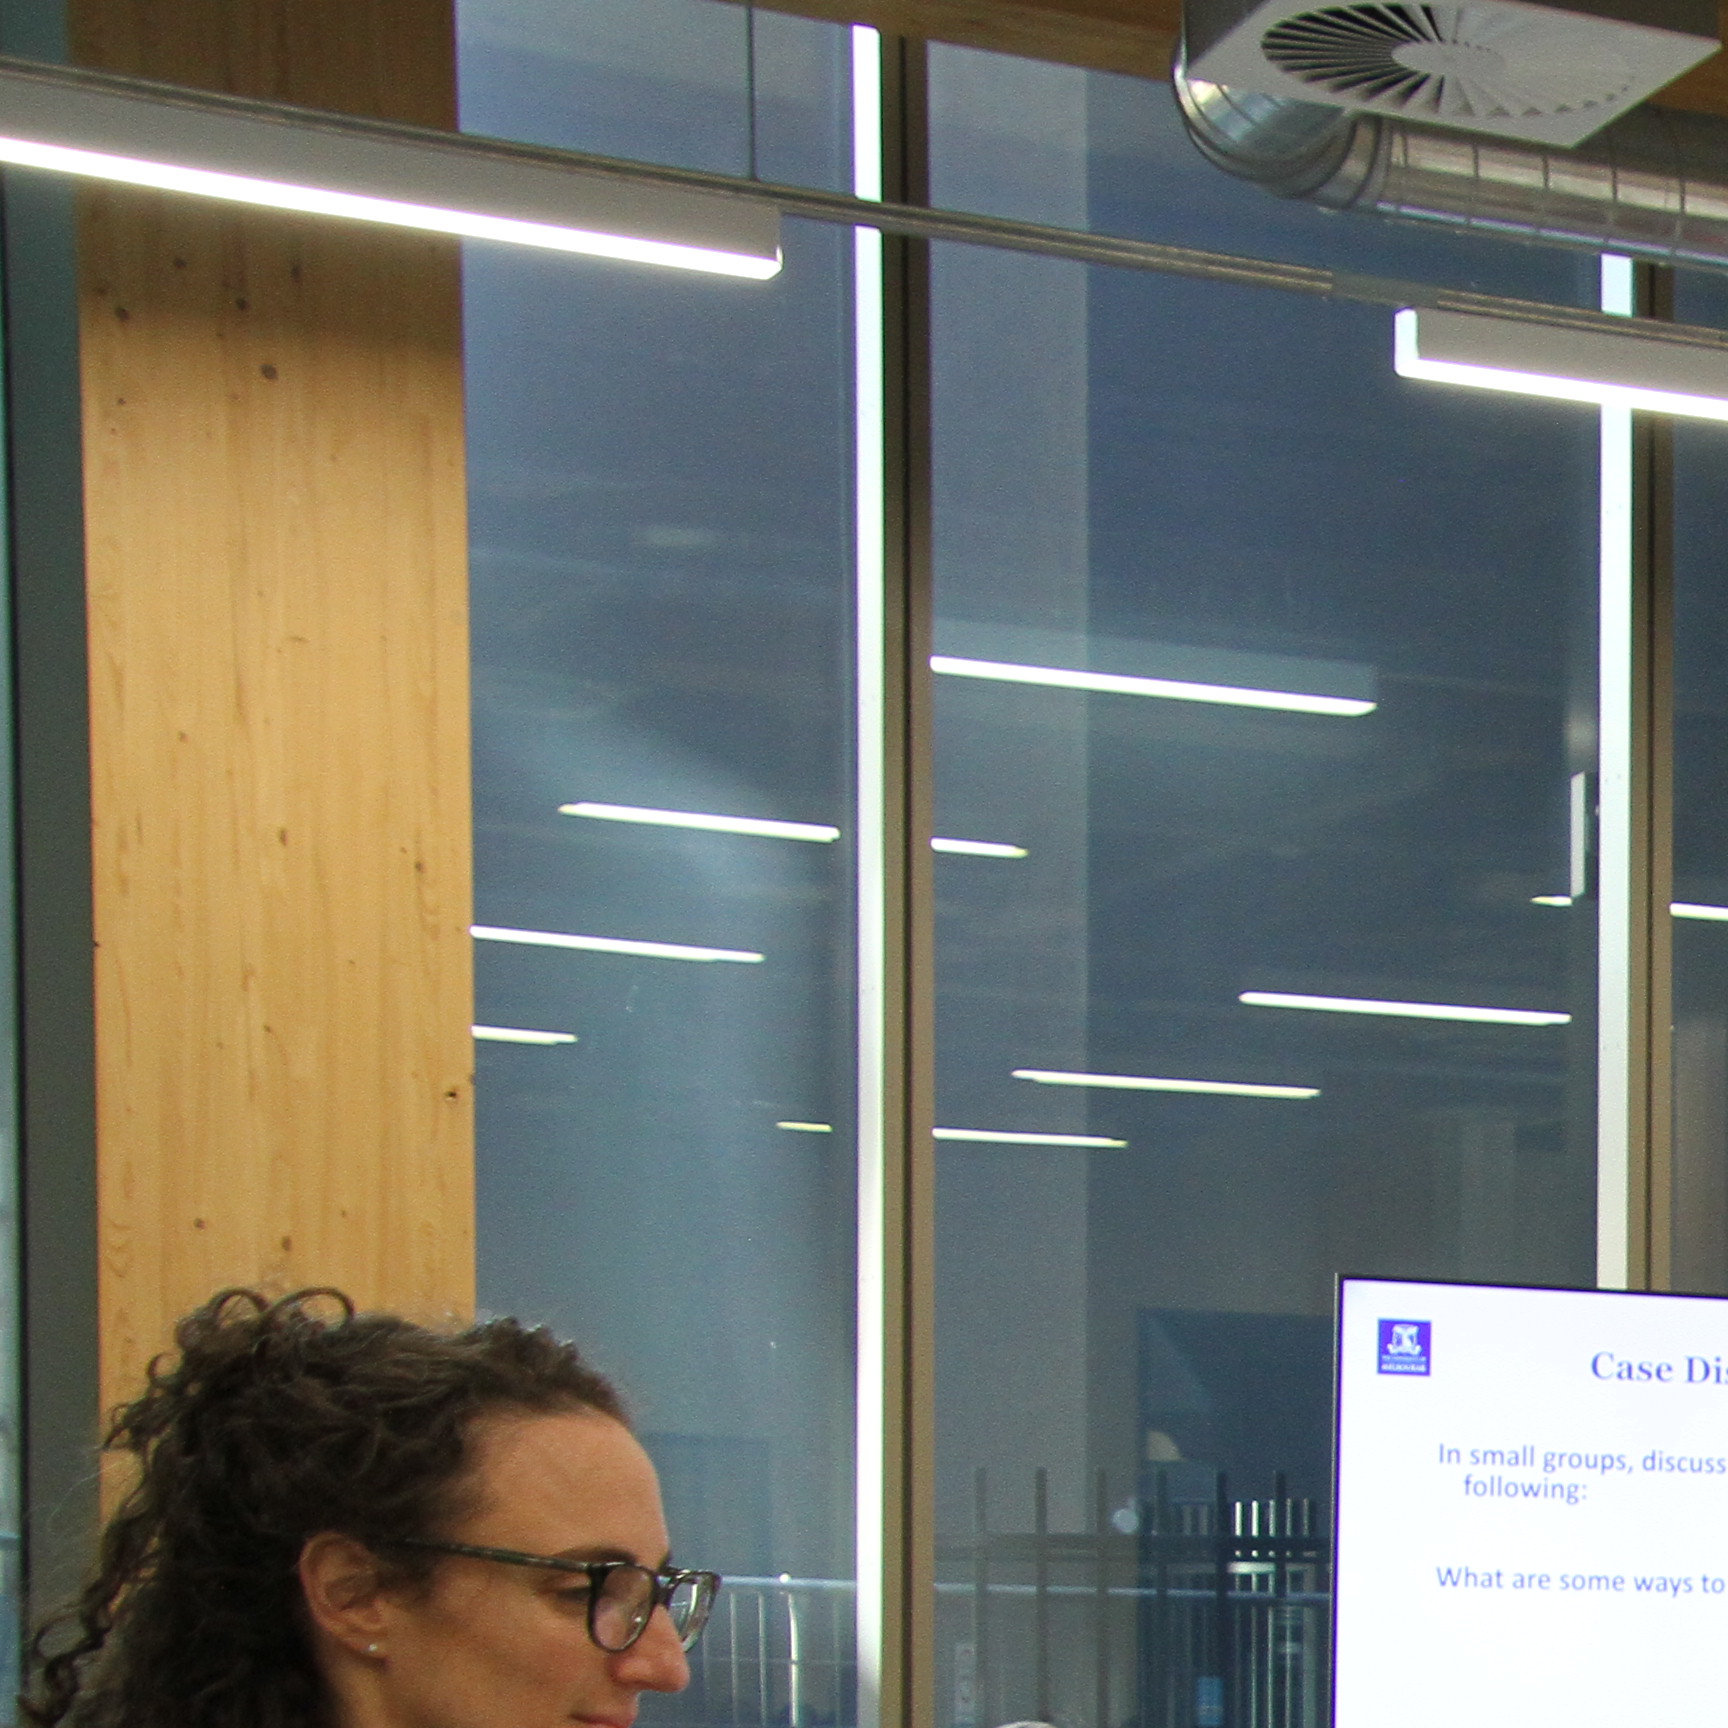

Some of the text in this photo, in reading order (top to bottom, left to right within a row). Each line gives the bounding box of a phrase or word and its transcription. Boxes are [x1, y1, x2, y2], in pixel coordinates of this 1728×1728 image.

[1589, 1351, 1674, 1383] Case
[1438, 1442, 1461, 1465] In
[1469, 1444, 1535, 1467] small
[1542, 1451, 1634, 1477] groups,
[1641, 1449, 1727, 1475] discuss
[1463, 1474, 1588, 1506] following:
[1435, 1565, 1504, 1590] What
[1511, 1572, 1551, 1591] are
[1559, 1573, 1626, 1592] some
[1633, 1574, 1694, 1599] ways
[1700, 1573, 1726, 1594] to
